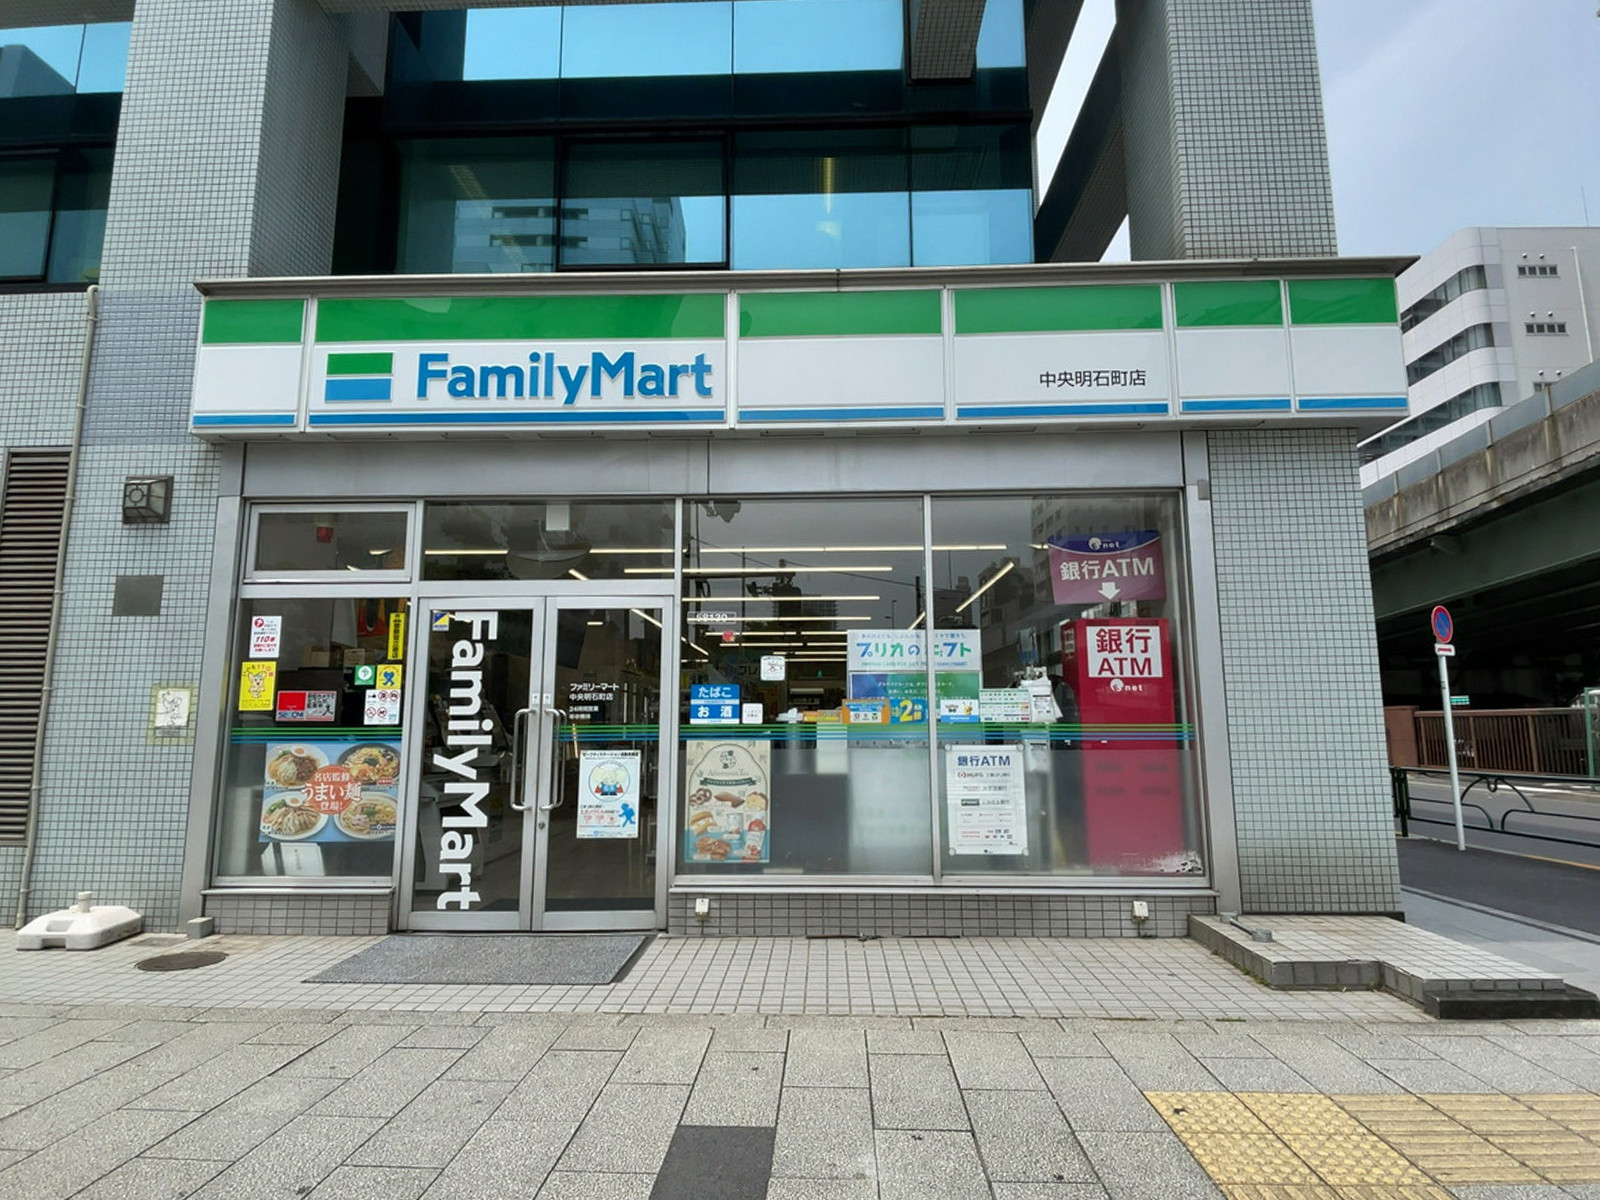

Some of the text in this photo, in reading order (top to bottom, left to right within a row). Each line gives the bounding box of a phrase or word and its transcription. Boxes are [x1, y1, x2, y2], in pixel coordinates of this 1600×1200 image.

[417, 351, 714, 405] FamilyMart
[1039, 369, 1147, 388] 中央明石町店
[1060, 557, 1155, 581] 銀行ATM
[856, 642, 972, 658] プリカのフト
[1096, 628, 1152, 653] 銀行
[1098, 657, 1152, 676] ATM
[570, 683, 620, 692] ファミリーマート
[698, 686, 732, 698] たばこ
[697, 705, 733, 718] お酒
[432, 611, 499, 910] FamilyMart
[957, 755, 1011, 767] 銀行ATM
